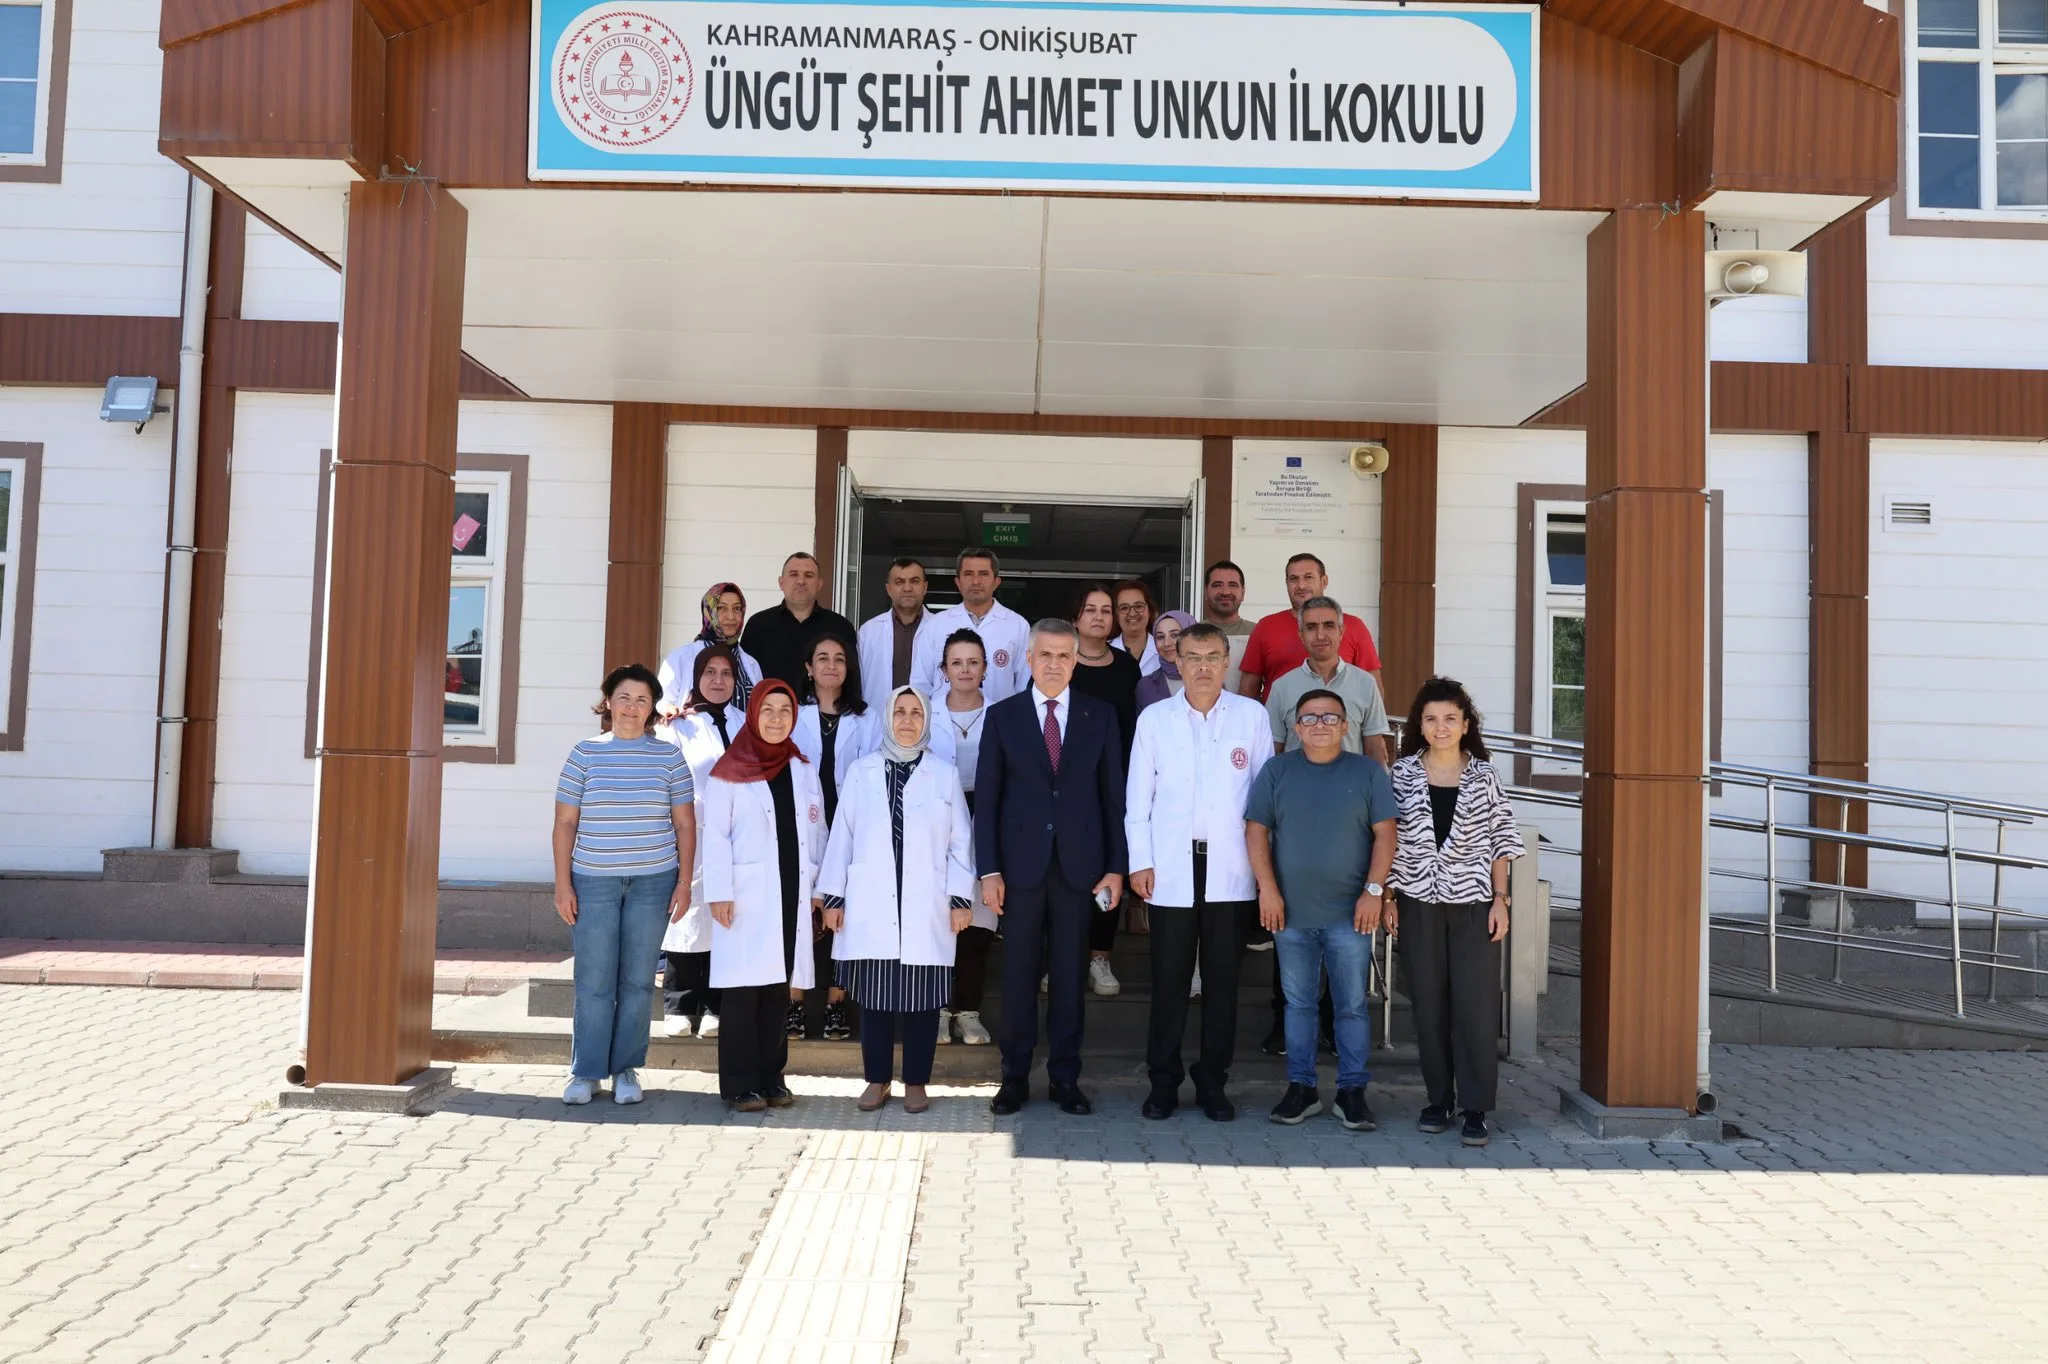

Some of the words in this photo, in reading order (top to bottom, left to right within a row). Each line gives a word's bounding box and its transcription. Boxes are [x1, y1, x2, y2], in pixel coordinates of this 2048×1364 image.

[623, 36, 648, 48] MİLLİ
[708, 25, 956, 56] KAHRAMANMARAŞ
[979, 27, 1137, 58] ONİKİŞUBAT
[584, 38, 621, 88] CUMHURİYETİ
[649, 47, 668, 77] EĞİTİM
[586, 91, 616, 120] TÜRKİYE
[635, 79, 668, 120] BAKANLIĞI
[706, 56, 847, 131] ÜNGÜT
[858, 60, 969, 149] ŞEHİT
[980, 76, 1122, 136] AHMET
[1134, 80, 1277, 141] UNKUN
[1290, 68, 1484, 145] İLKOKULU
[993, 535, 1019, 543] ÇIKIŞ
